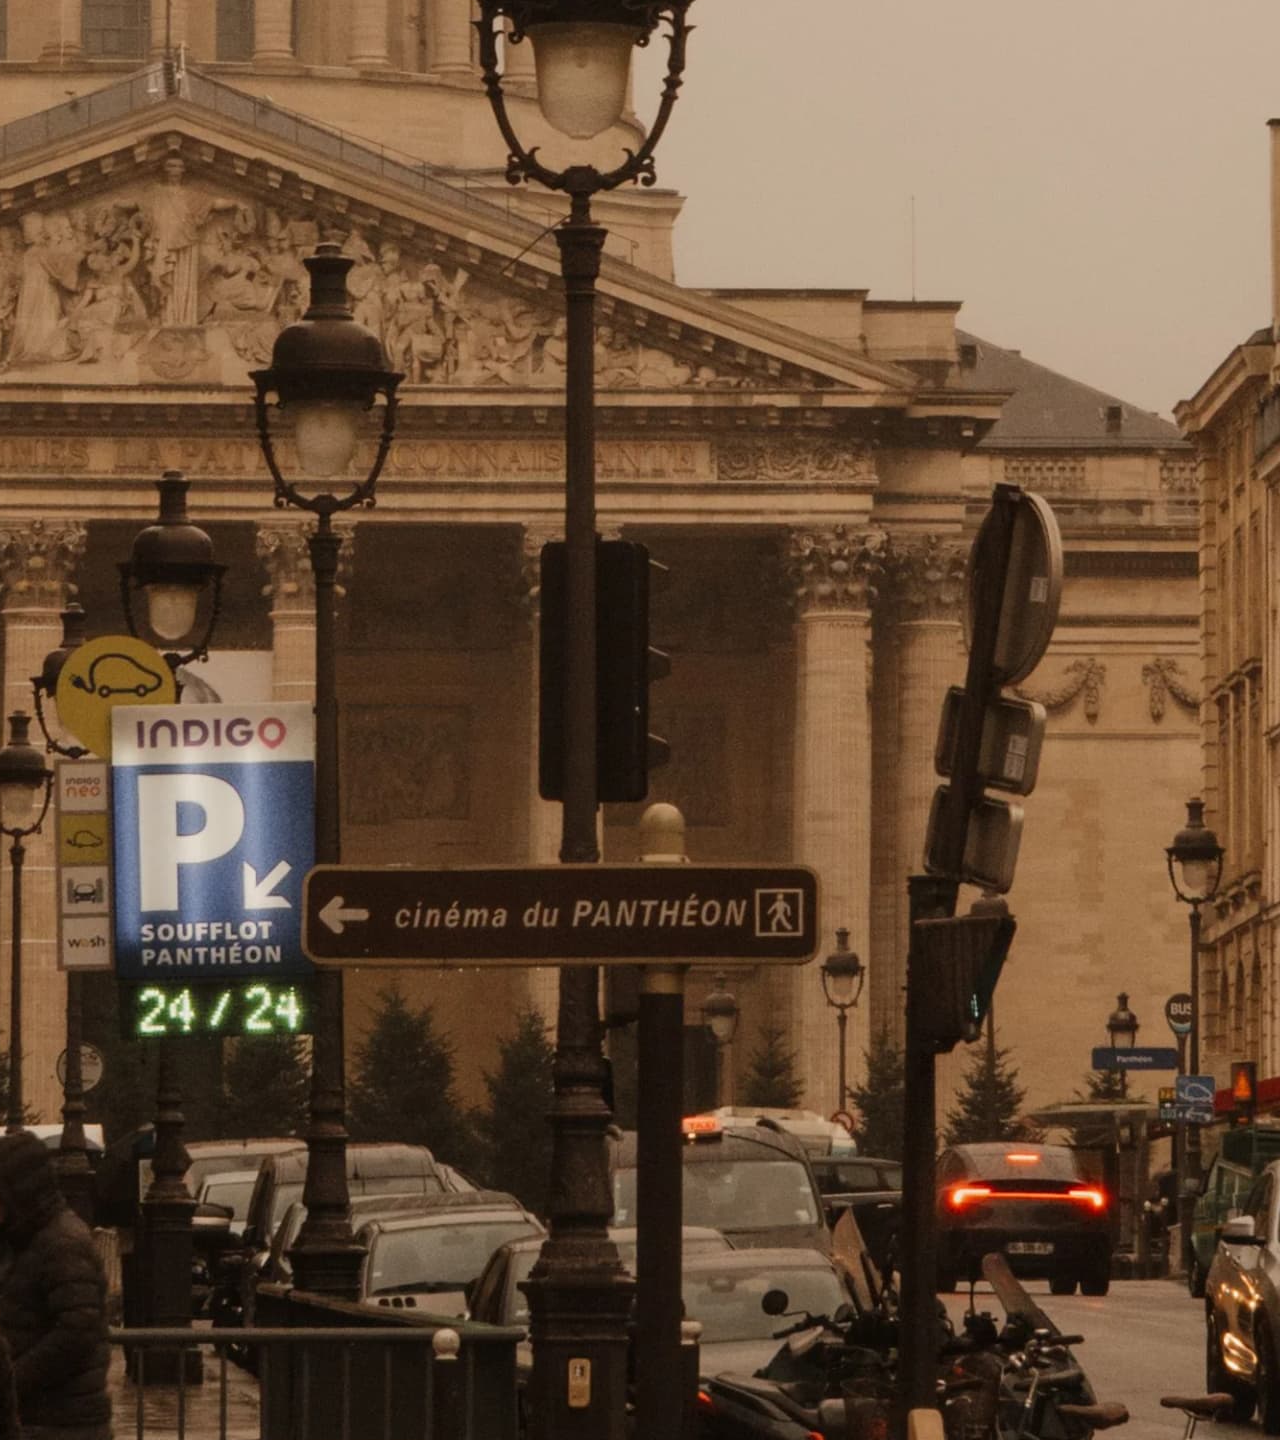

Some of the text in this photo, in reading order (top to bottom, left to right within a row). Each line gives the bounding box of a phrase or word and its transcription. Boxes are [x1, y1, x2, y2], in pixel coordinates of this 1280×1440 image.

[136, 717, 287, 749] INDIGO
[66, 785, 101, 798] neo
[137, 773, 246, 912] P
[393, 893, 748, 929] cinéma du PANTHÉON
[139, 920, 273, 942] SOUFFLOT
[141, 942, 282, 966] PANTHÉON
